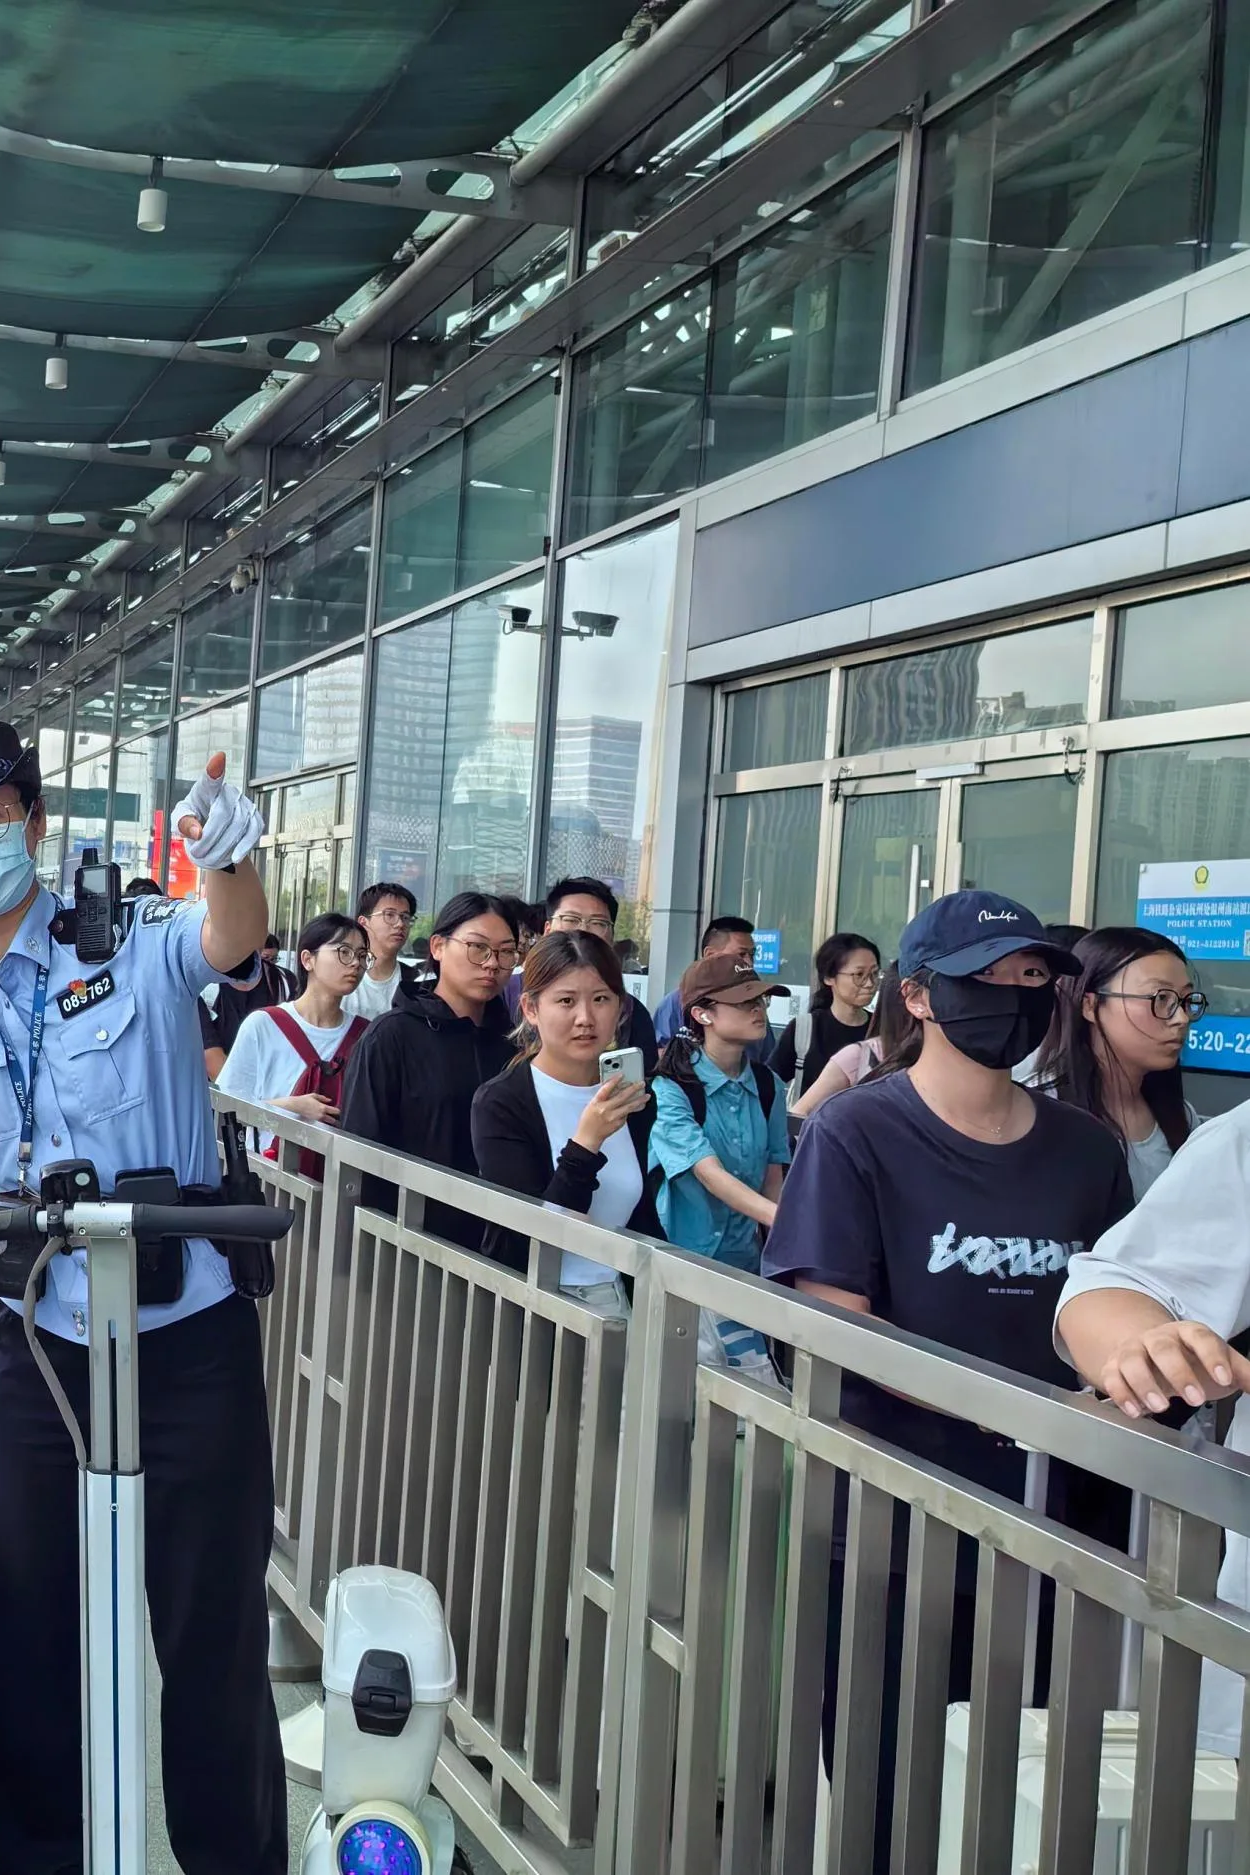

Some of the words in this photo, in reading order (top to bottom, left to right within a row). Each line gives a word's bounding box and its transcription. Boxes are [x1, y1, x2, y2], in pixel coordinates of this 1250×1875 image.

[1166, 919, 1195, 928] POLICE
[1197, 919, 1232, 928] STATION
[33, 1011, 42, 1039] POLICE
